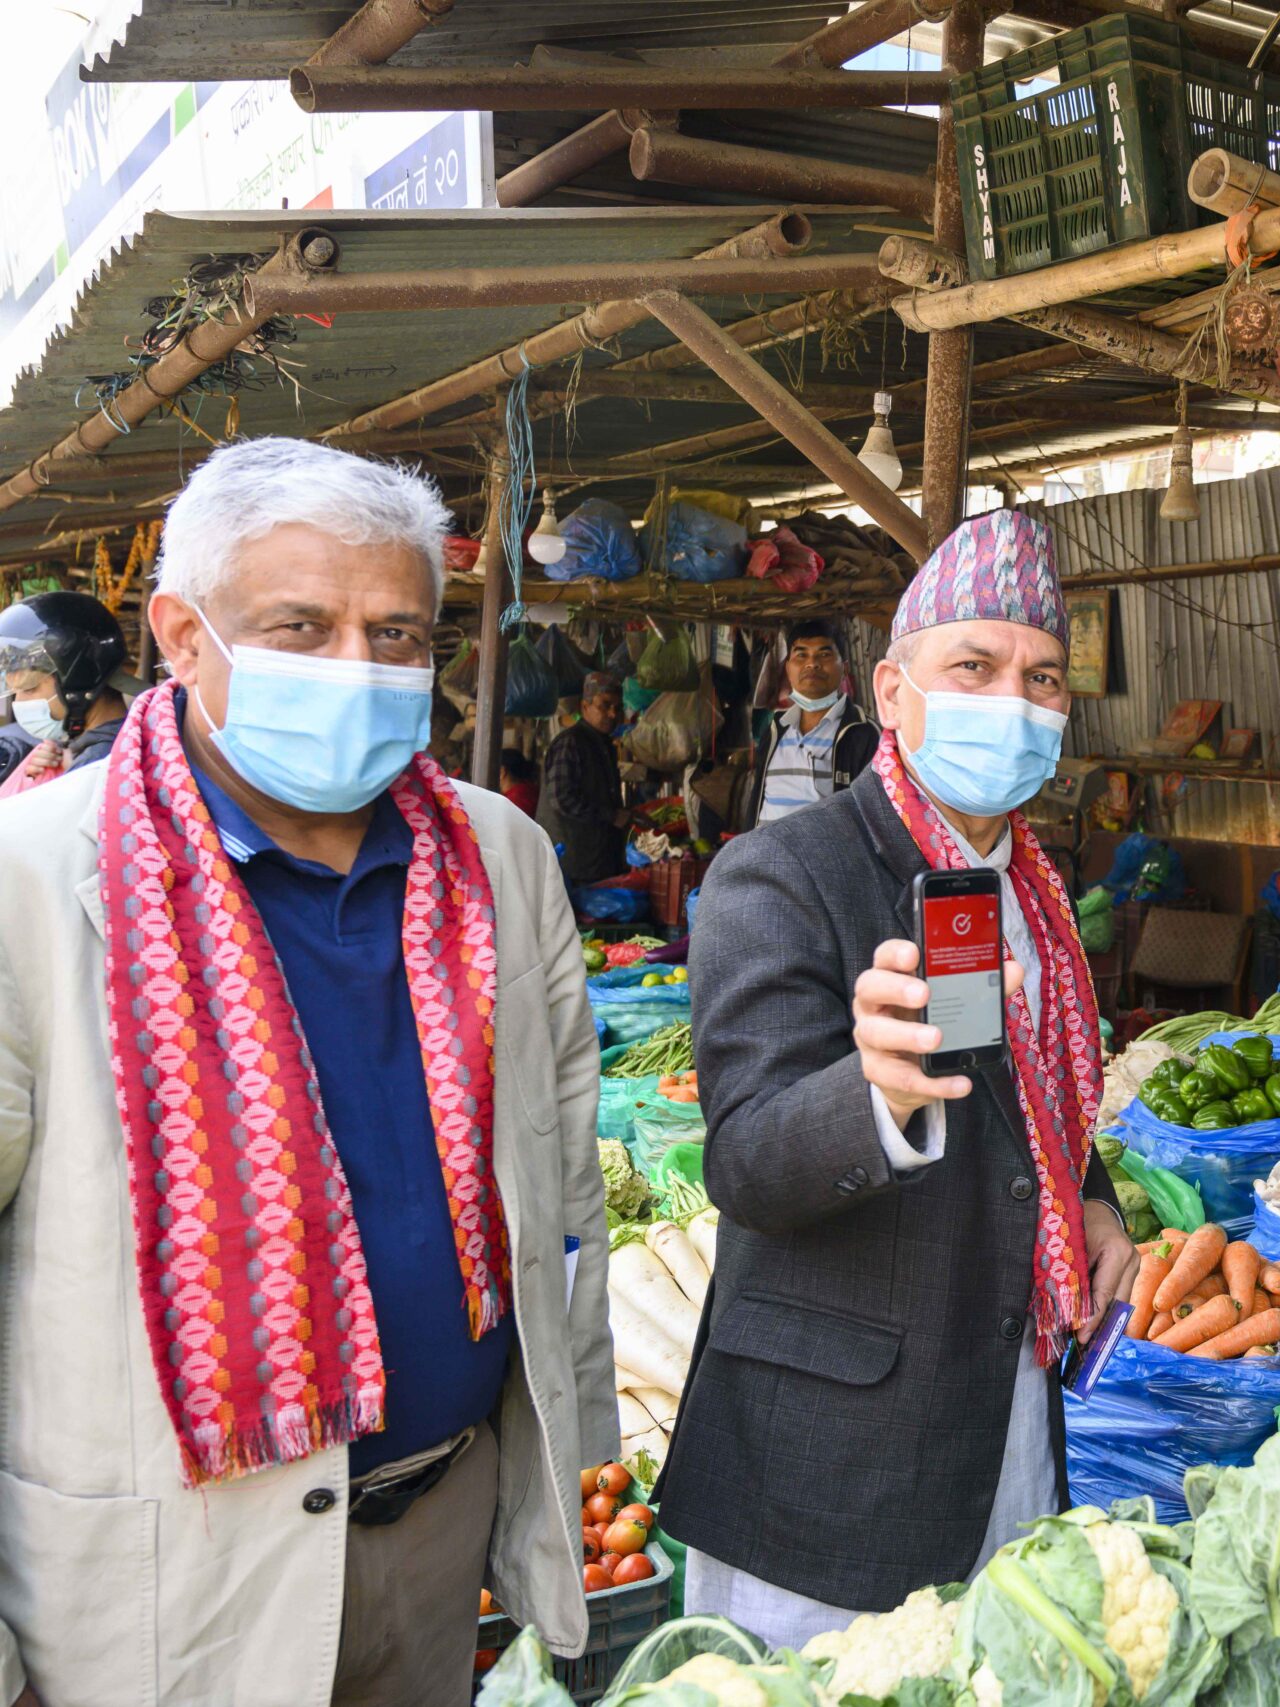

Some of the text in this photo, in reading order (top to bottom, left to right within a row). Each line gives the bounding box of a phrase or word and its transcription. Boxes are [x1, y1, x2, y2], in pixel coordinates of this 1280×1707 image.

[434, 148, 459, 194] २०
[973, 144, 996, 260] SHYAM
[1107, 82, 1133, 207] RAJA
